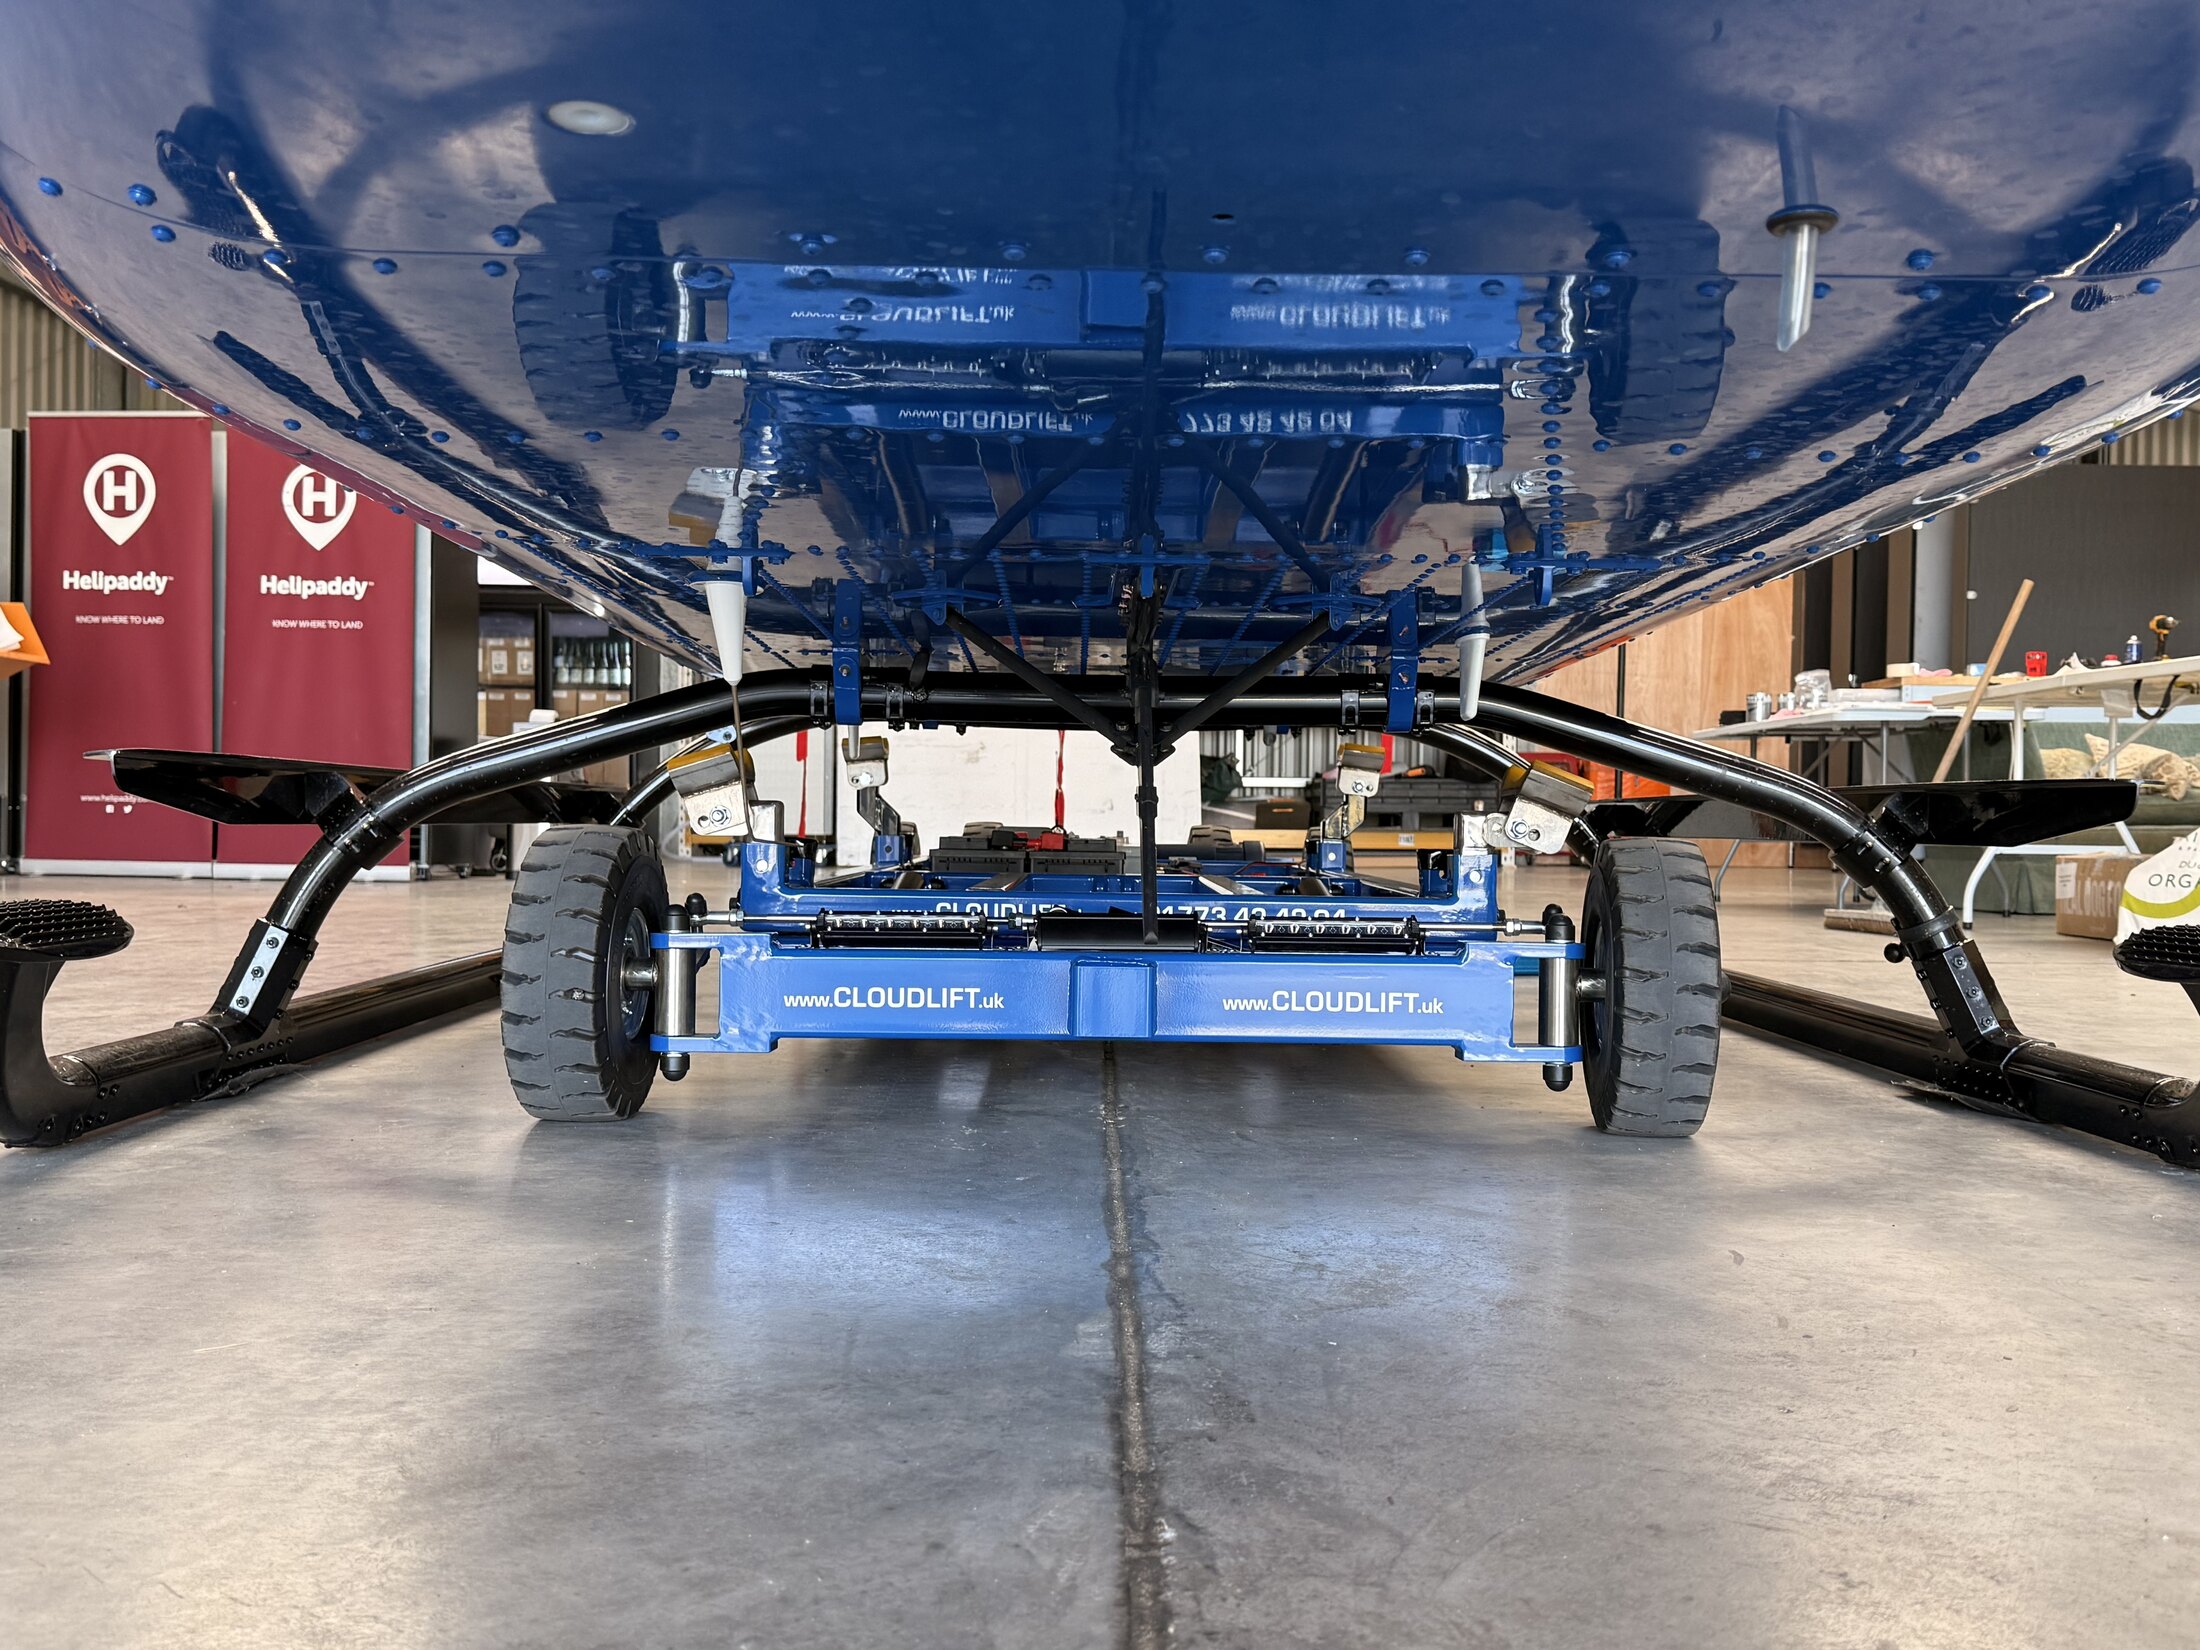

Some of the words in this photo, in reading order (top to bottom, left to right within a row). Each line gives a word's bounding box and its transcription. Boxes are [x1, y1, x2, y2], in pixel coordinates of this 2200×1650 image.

[75, 615, 101, 624] KNOW
[101, 615, 129, 624] WHERE
[129, 615, 142, 625] TO
[142, 616, 165, 625] LAND
[272, 619, 298, 628] KNOW
[298, 619, 327, 629] WHERE
[327, 620, 340, 629] TO
[341, 620, 364, 630] LAND
[783, 986, 1005, 1009] www.CLOUDLIFT.uk
[1222, 990, 1444, 1014] www.CLOUDLIFT.uk
